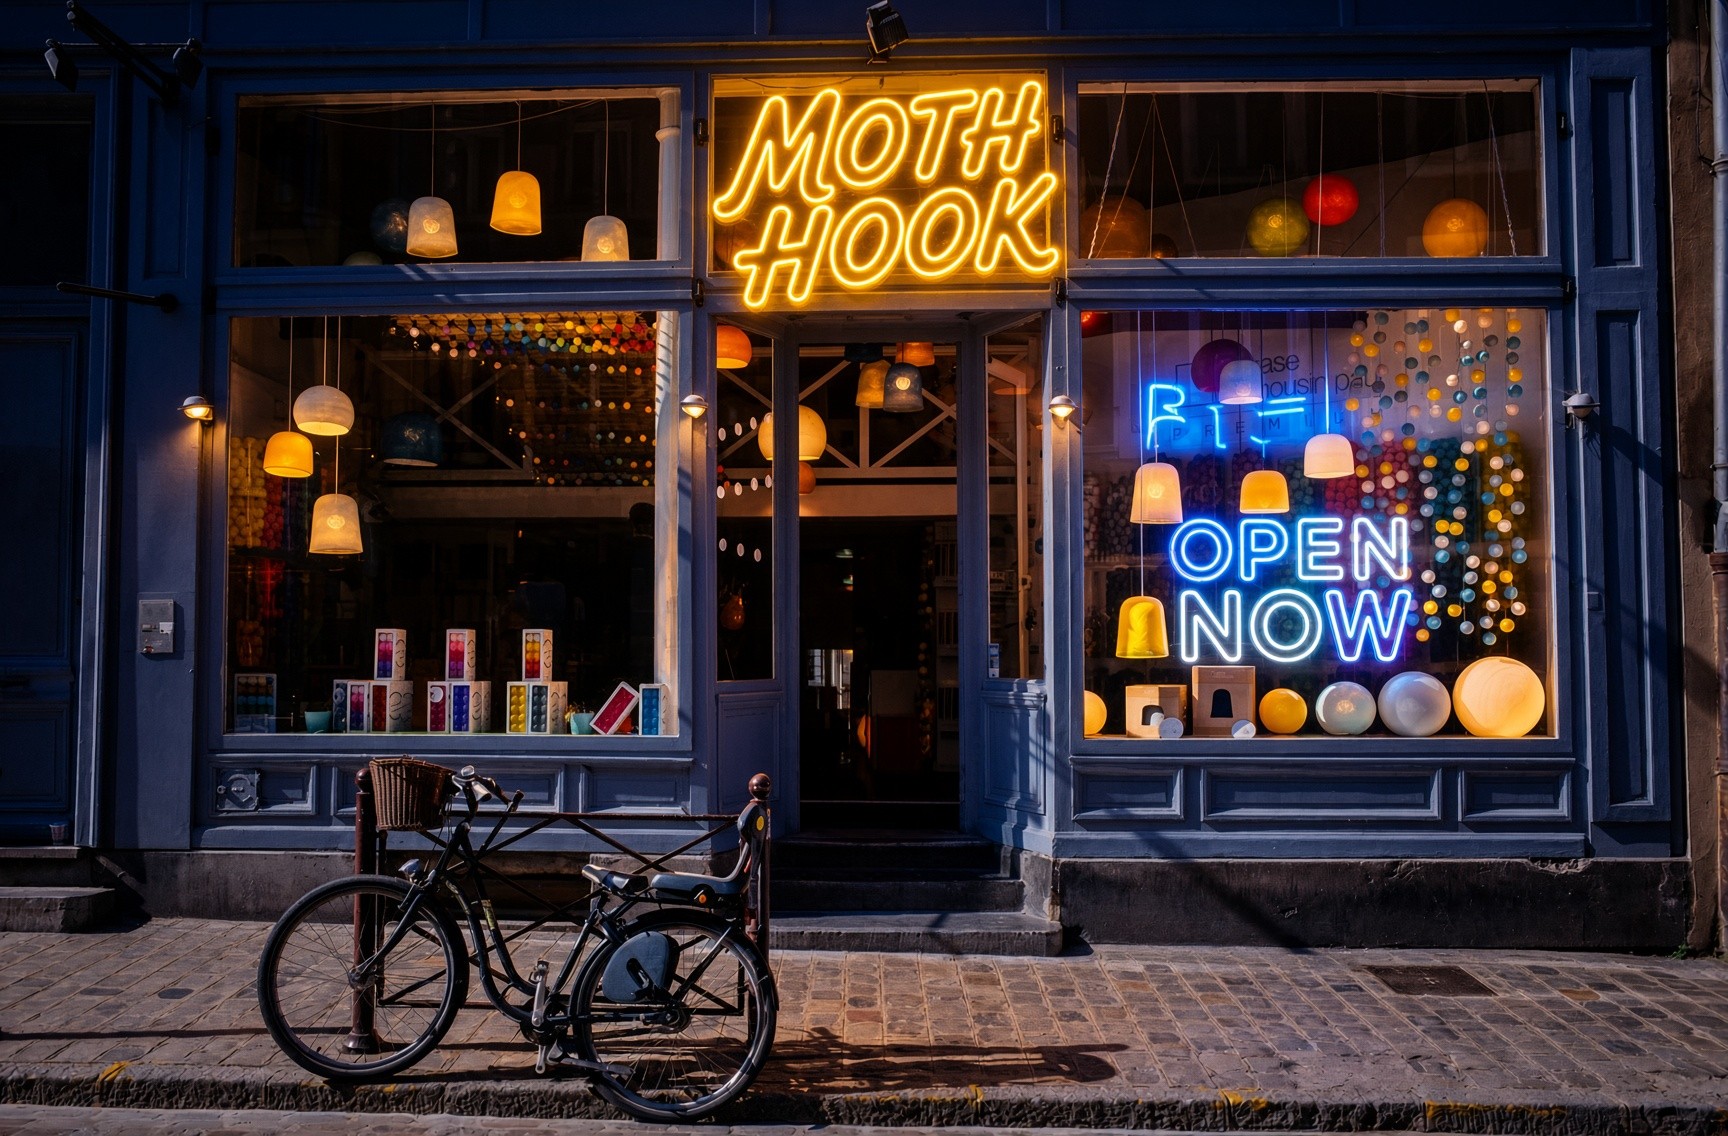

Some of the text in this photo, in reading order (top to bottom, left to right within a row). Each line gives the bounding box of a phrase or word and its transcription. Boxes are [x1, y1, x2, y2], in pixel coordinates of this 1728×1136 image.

[713, 80, 1042, 218] MOTH
[732, 172, 1060, 308] HOOK
[1170, 517, 1408, 581] OPEN
[1179, 588, 1412, 663] NOW
